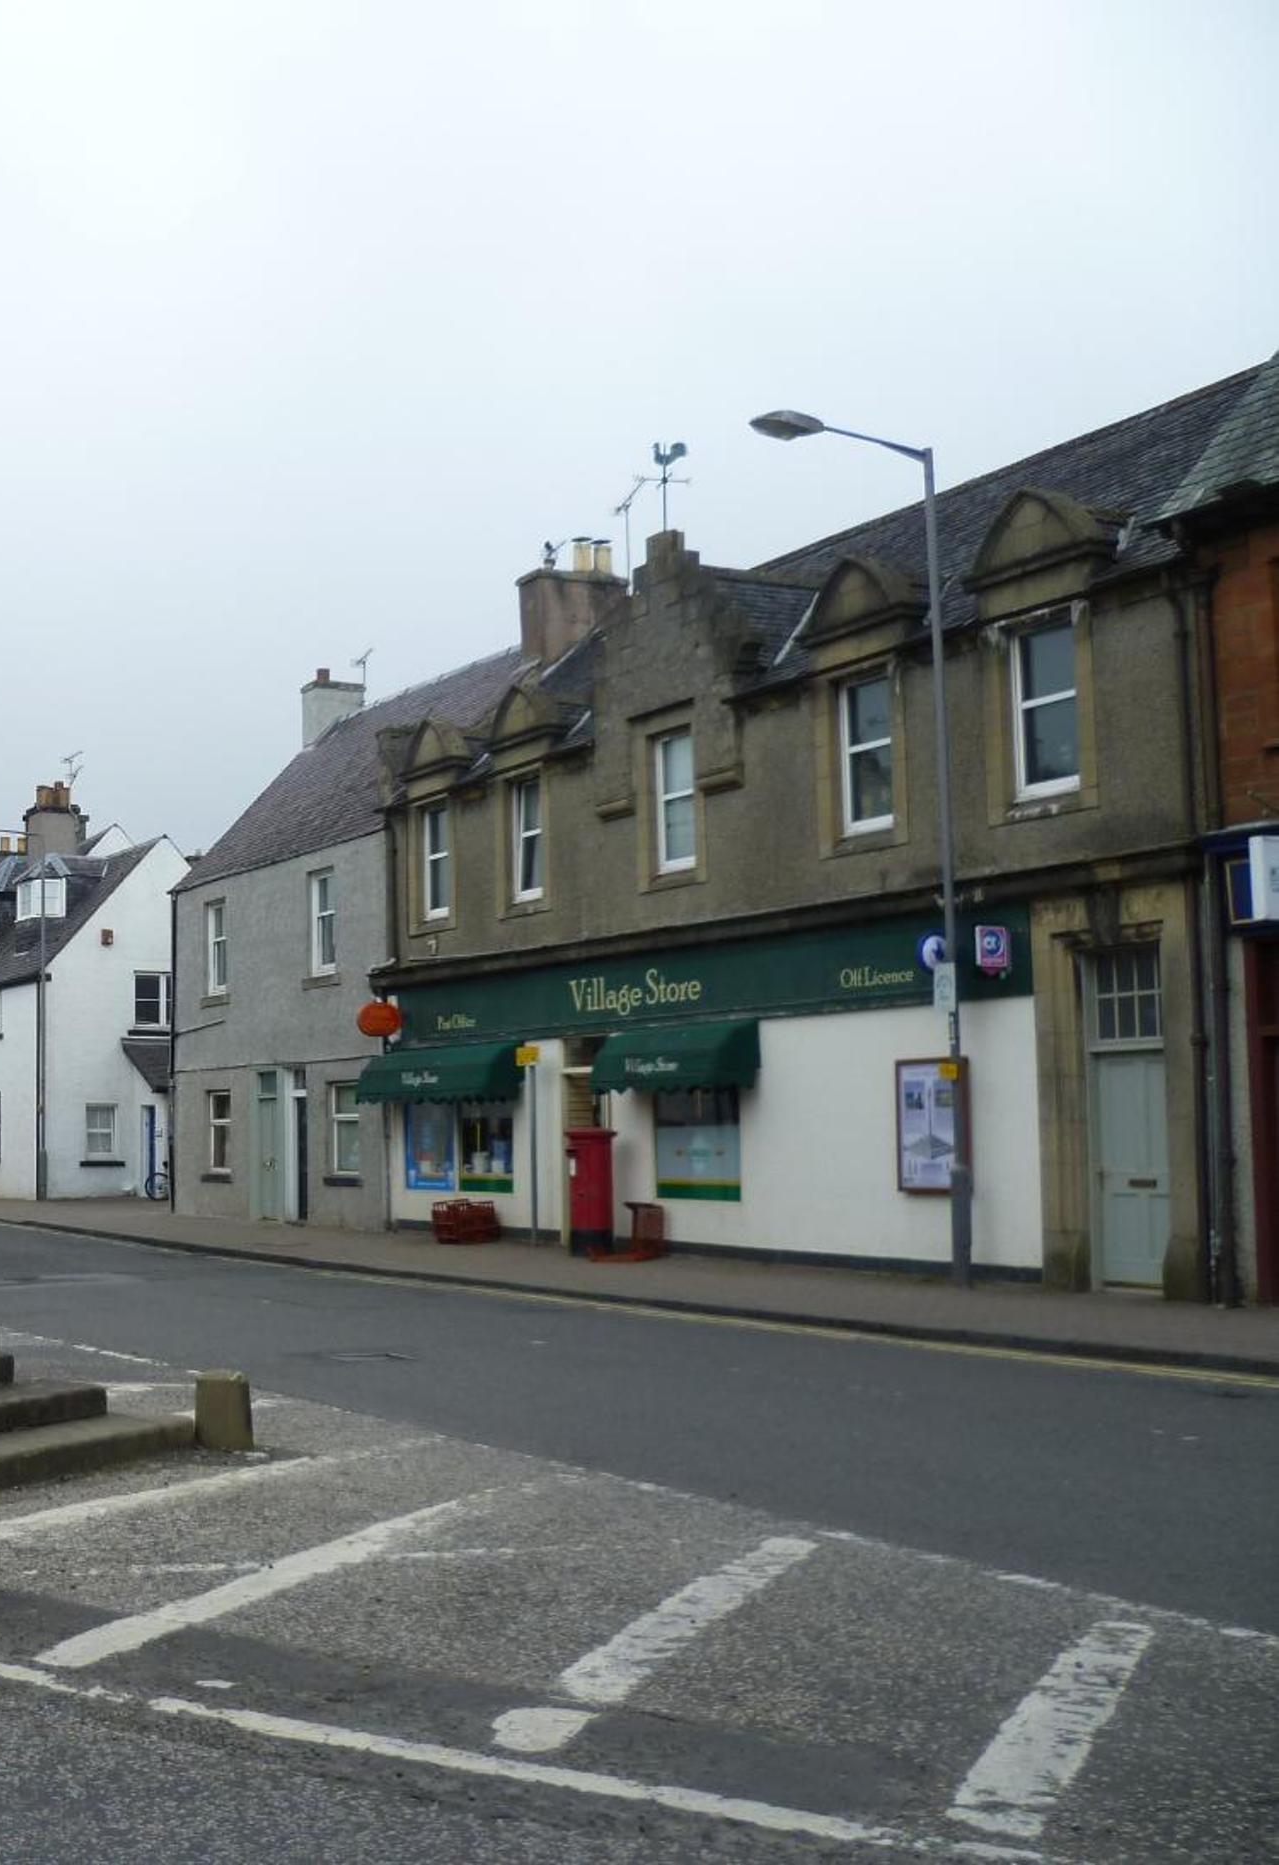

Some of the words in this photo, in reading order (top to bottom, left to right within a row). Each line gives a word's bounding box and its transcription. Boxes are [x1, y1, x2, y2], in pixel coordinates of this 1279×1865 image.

[569, 976, 643, 1015] Village
[645, 968, 701, 1004] Store
[864, 965, 914, 987] Licence
